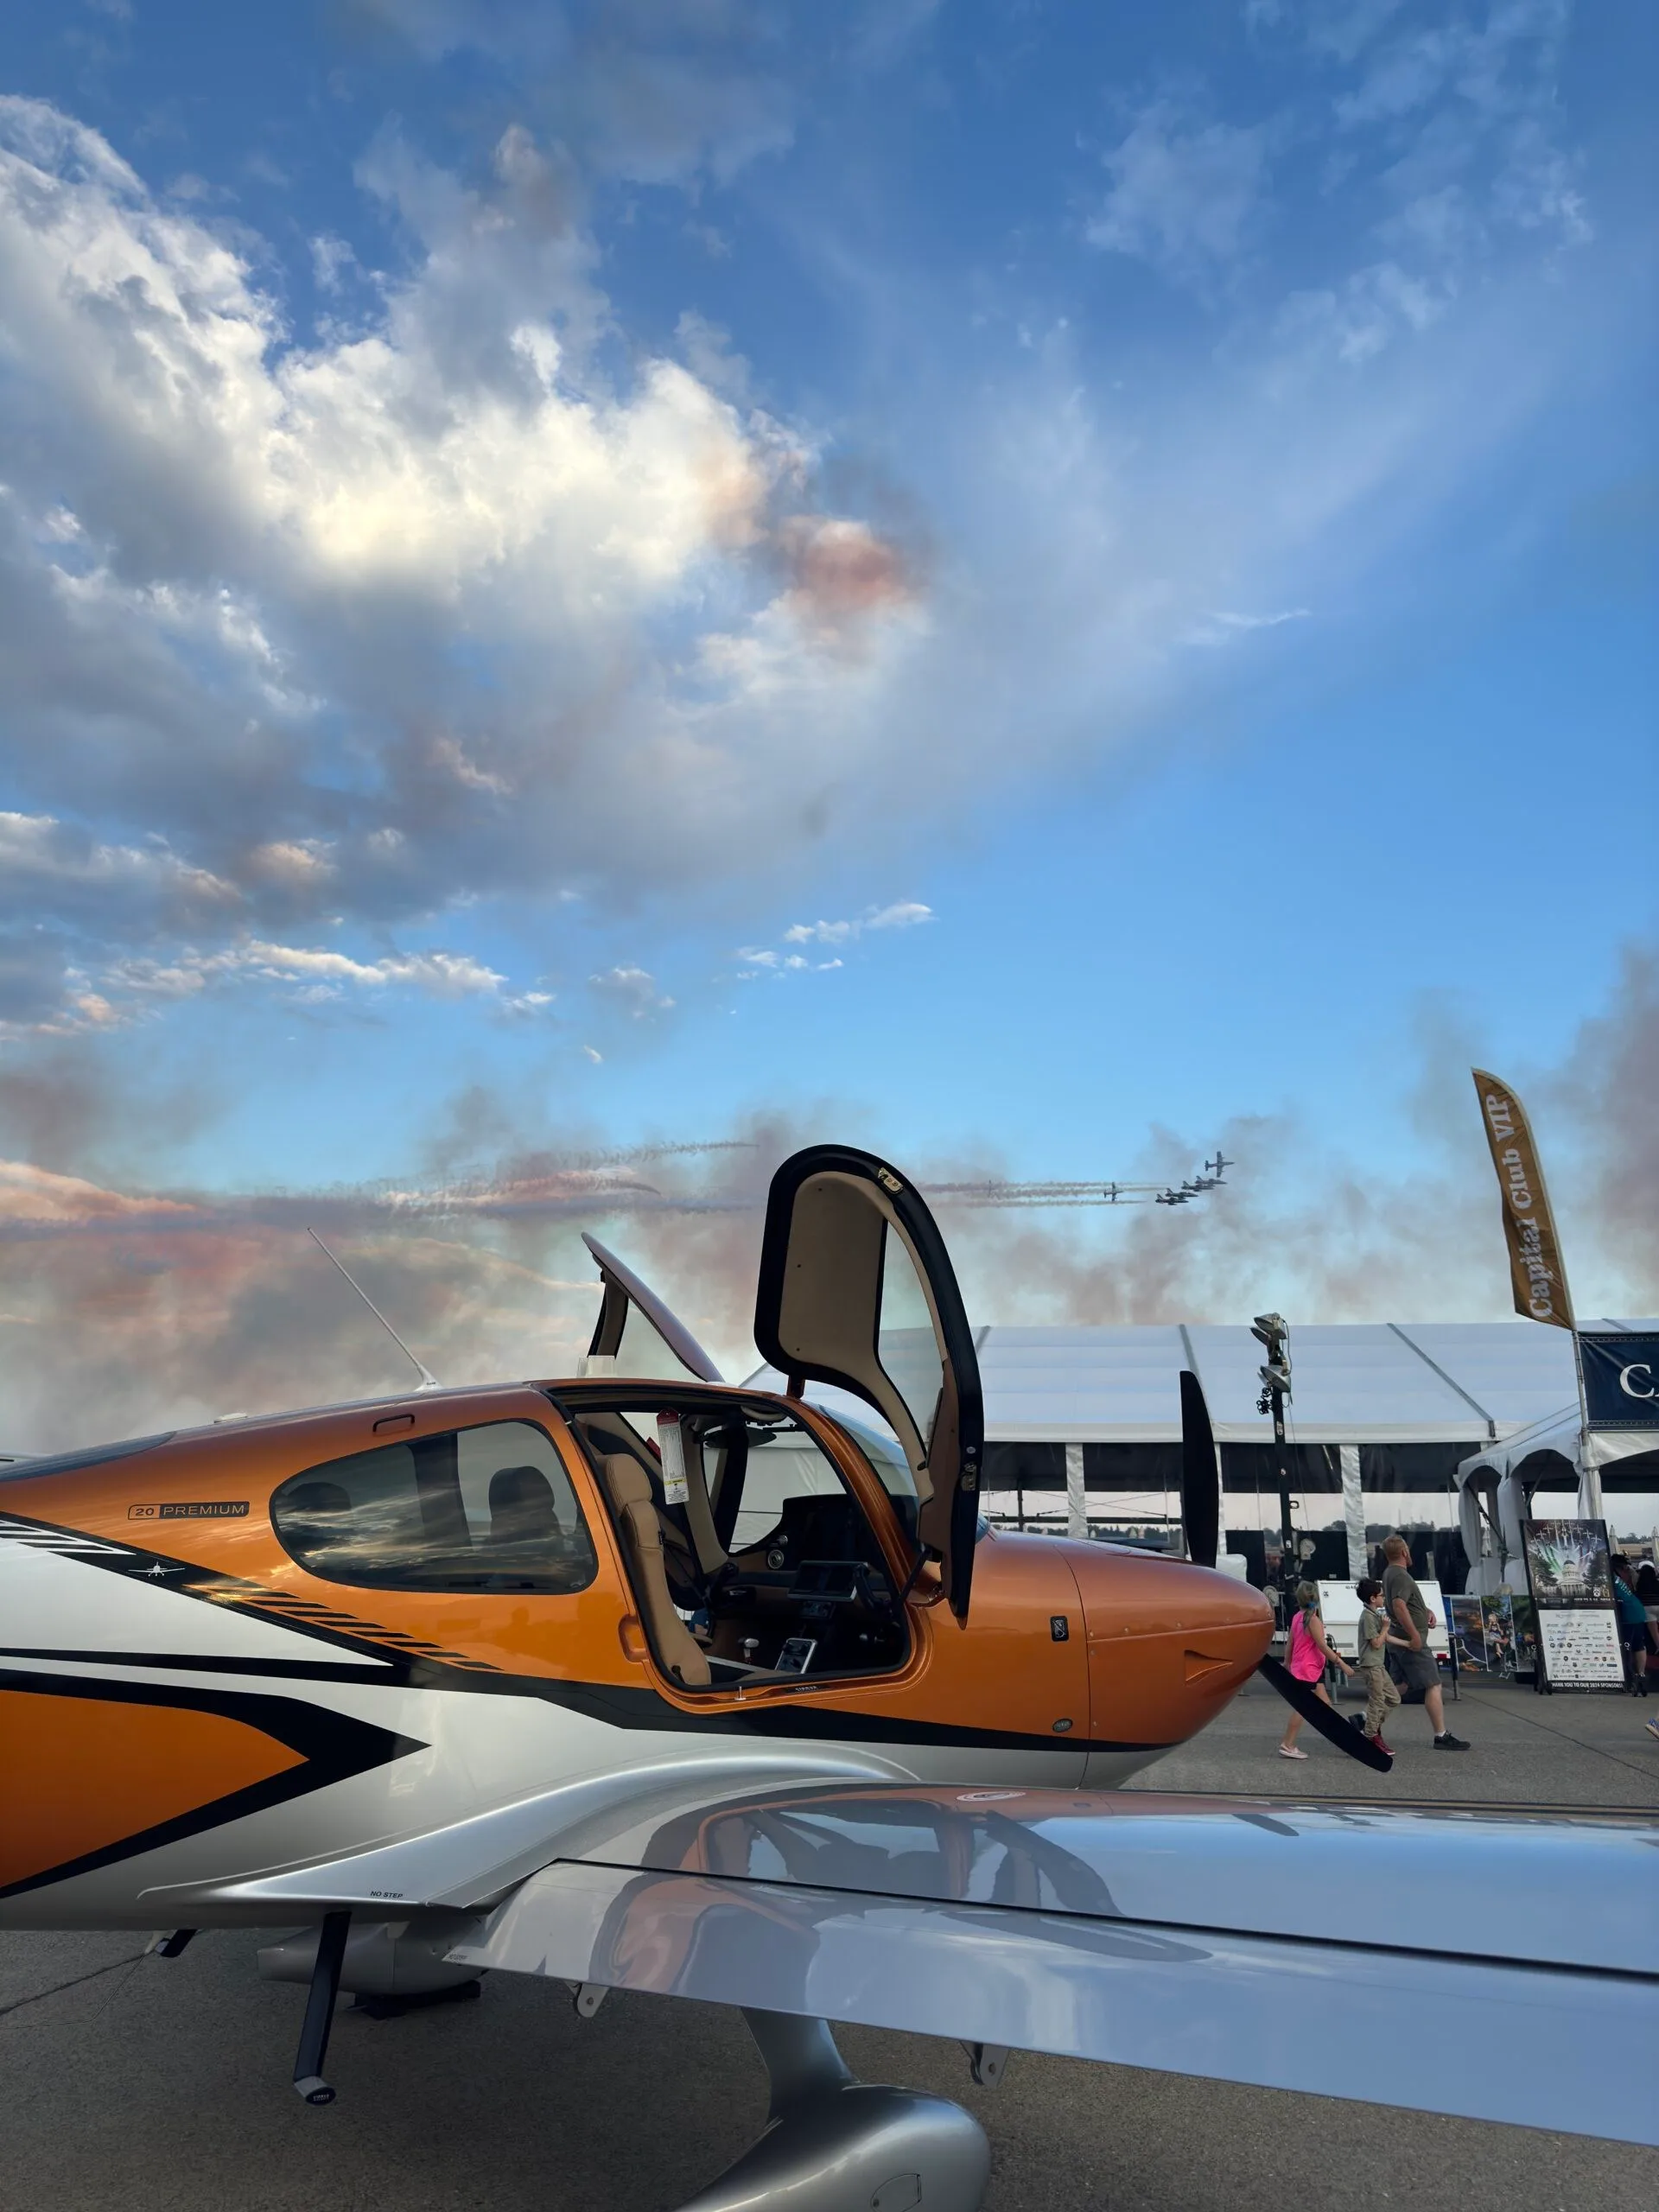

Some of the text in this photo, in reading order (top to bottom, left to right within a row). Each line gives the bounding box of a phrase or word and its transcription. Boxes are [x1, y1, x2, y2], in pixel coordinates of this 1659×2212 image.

[1486, 1094, 1554, 1318] Capital Club VIP
[1619, 1363, 1659, 1398] C
[135, 1504, 245, 1516] 20 PREMIUM
